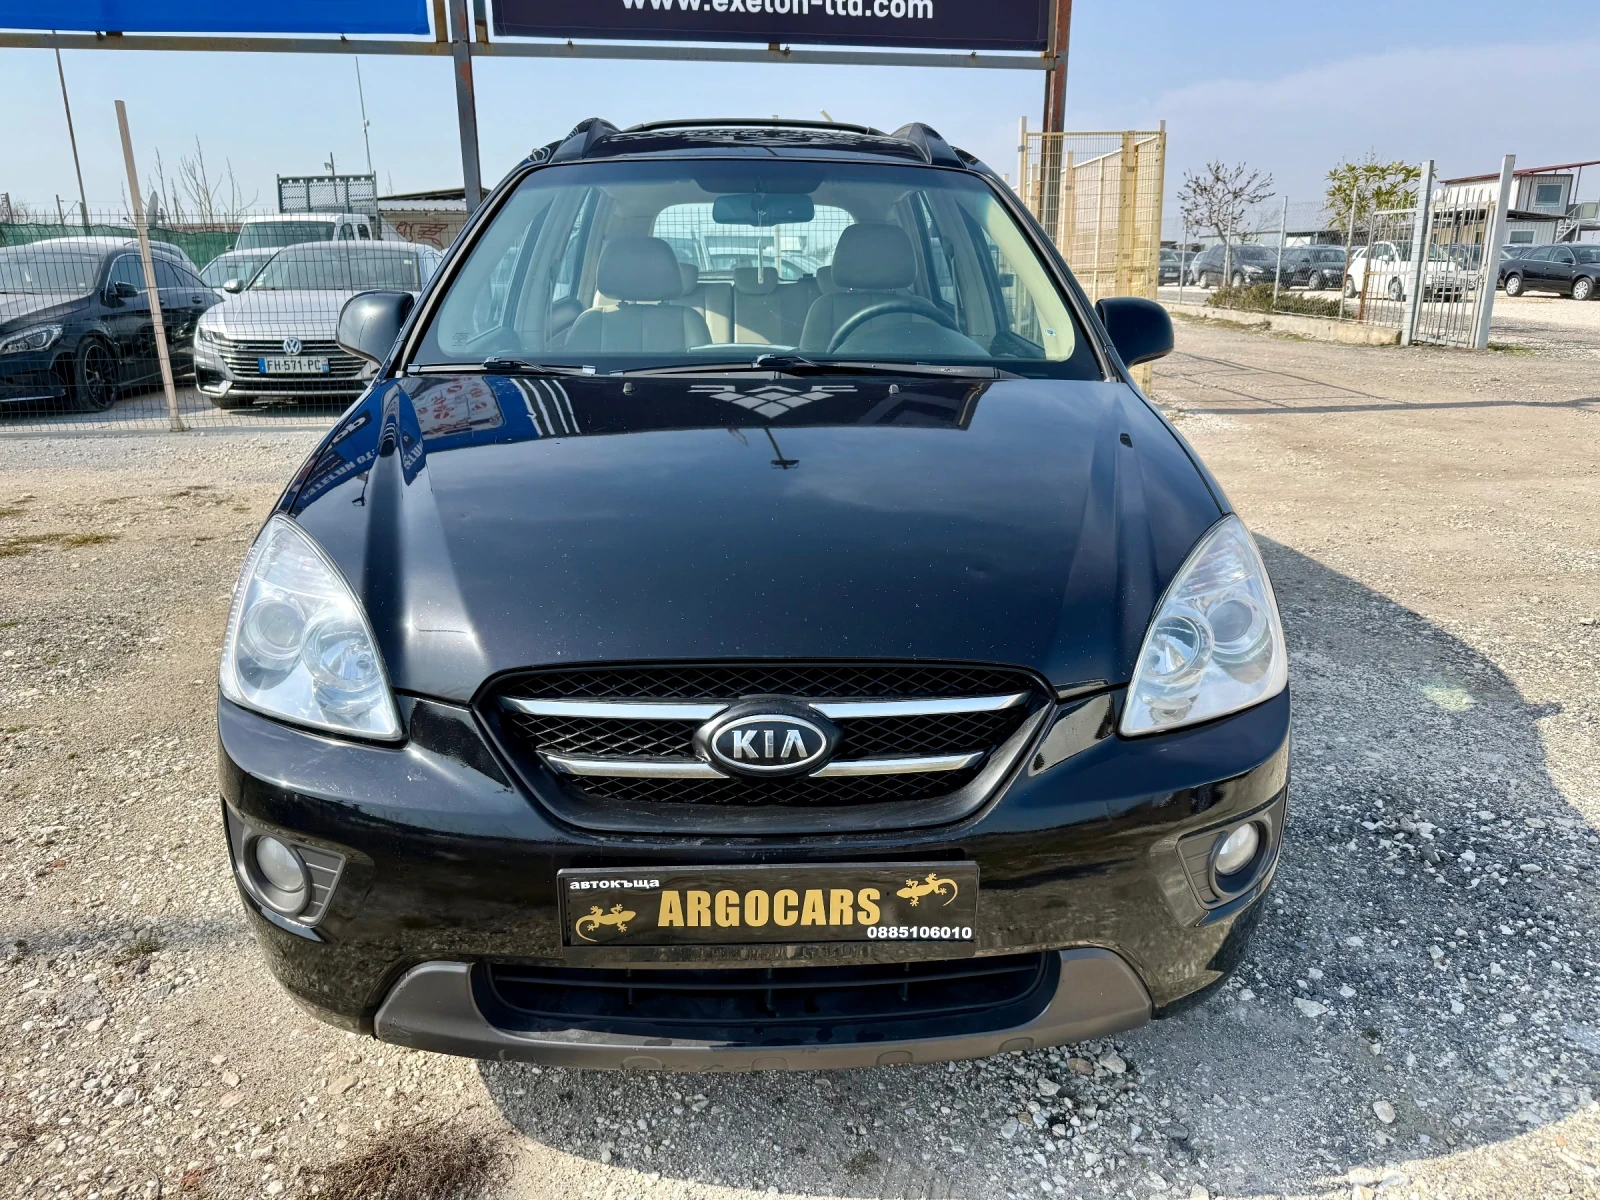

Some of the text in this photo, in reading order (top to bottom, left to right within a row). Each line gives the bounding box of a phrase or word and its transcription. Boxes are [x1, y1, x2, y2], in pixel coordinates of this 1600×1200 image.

[732, 729, 808, 759] KIA
[569, 878, 660, 890] автокъща
[657, 888, 881, 928] ARGOCARS
[866, 925, 972, 939] 0885106010
